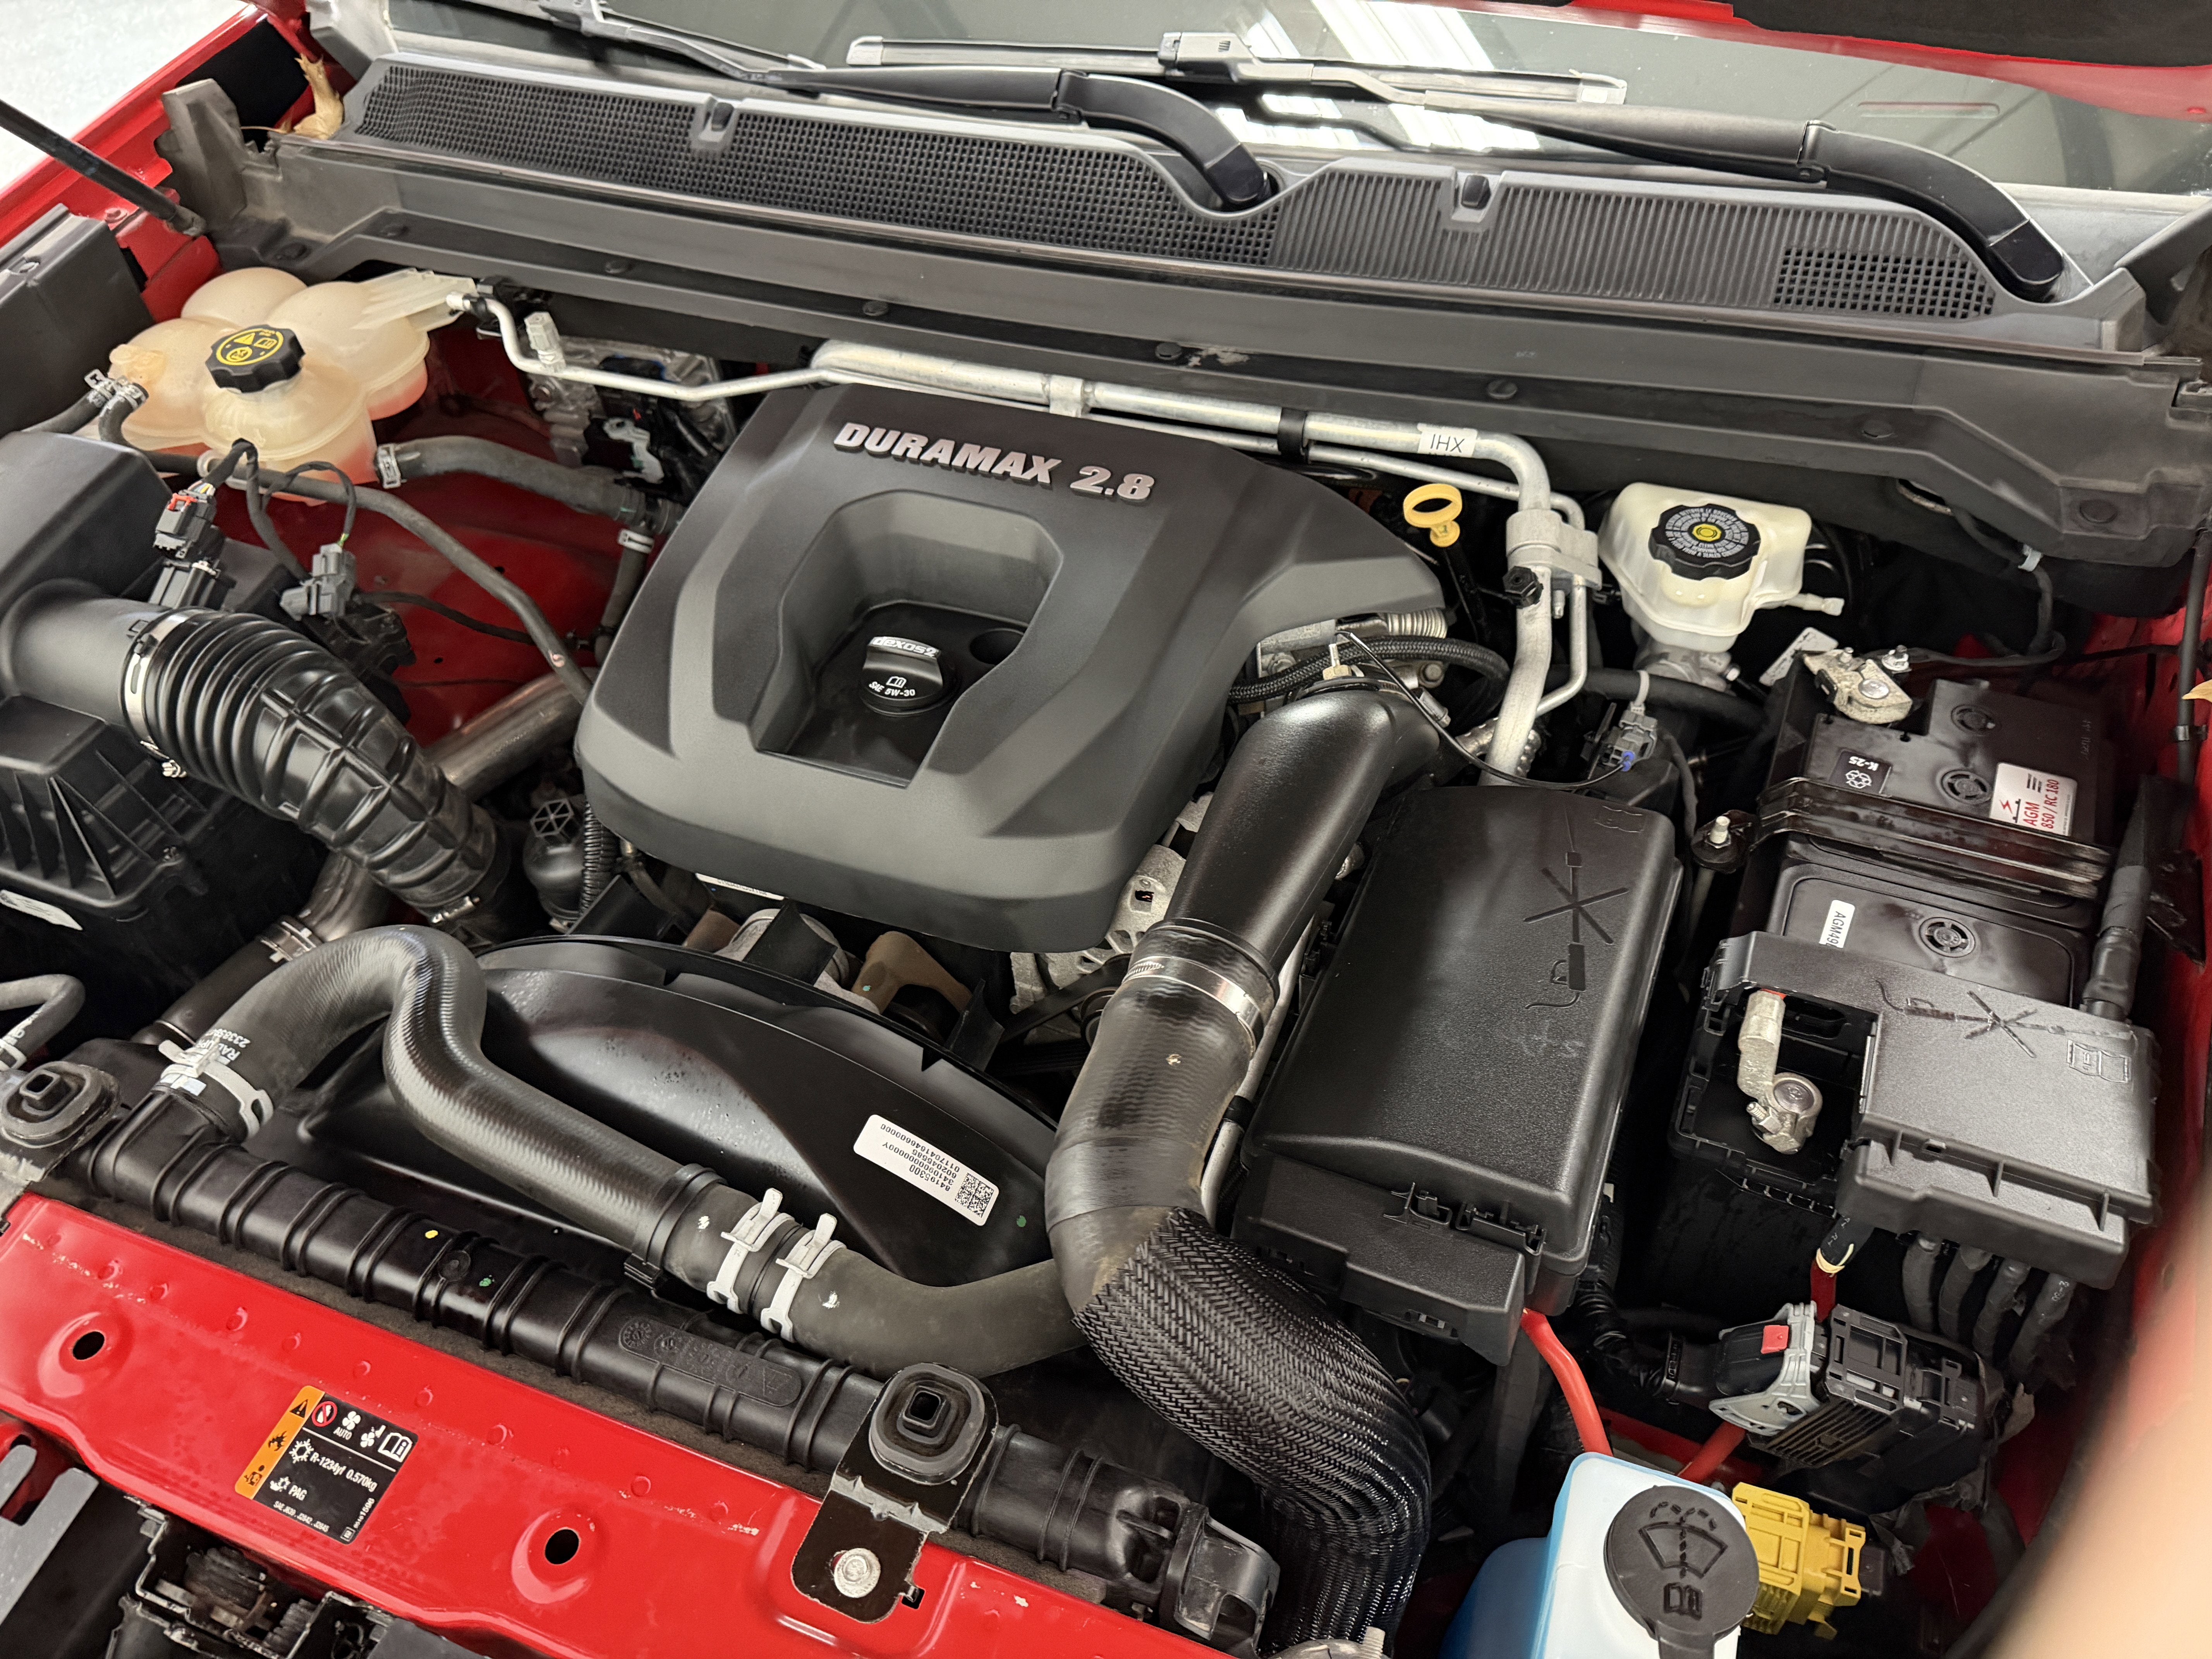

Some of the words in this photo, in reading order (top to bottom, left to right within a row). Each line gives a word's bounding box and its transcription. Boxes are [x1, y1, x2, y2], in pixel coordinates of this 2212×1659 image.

[833, 422, 1061, 484] DURAMAX
[1070, 465, 1156, 501] 2.8
[872, 636, 938, 657] dexos2
[869, 682, 884, 692] SAE
[2046, 779, 2059, 794] 180
[2044, 794, 2057, 807] RC
[2023, 802, 2040, 826] AGM
[2041, 813, 2055, 829] 850
[909, 1164, 951, 1192] 84195300
[334, 1427, 352, 1441] AUTO
[310, 1451, 346, 1476] R-1234yf
[345, 1468, 377, 1492] 0.570kg
[288, 1484, 308, 1501] PAG
